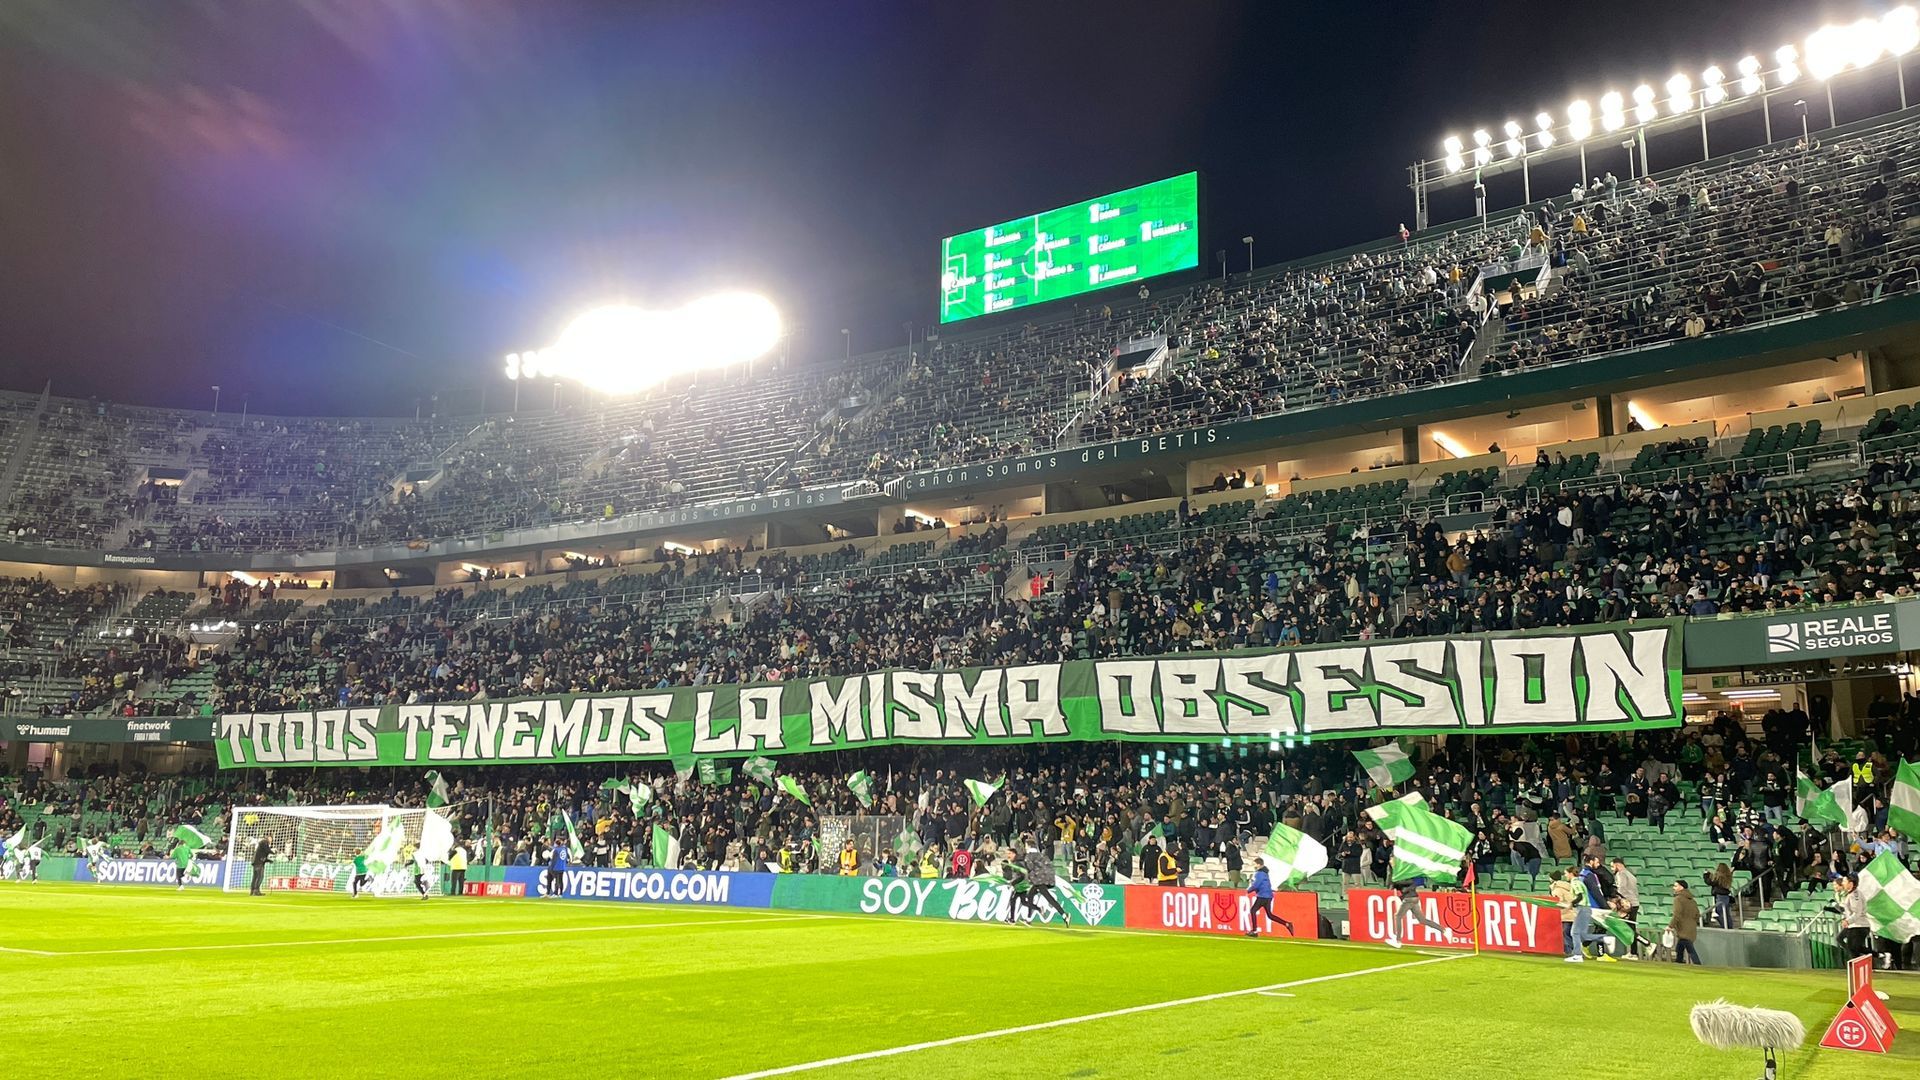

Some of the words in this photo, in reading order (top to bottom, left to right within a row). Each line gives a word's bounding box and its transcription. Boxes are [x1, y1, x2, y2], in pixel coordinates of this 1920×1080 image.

[713, 502, 757, 517] como
[772, 492, 825, 508] balas
[986, 457, 1057, 477] Somos
[1081, 445, 1117, 462] del
[1141, 429, 1230, 453] BETIS.
[104, 554, 155, 564] Manquepierda
[1803, 613, 1892, 637] REALE
[1805, 632, 1894, 650] SEGUROS
[221, 708, 381, 763] TODOS
[398, 693, 674, 760] TENEMOS
[691, 686, 785, 753] LA
[809, 662, 1070, 745] MISMA
[1094, 628, 1677, 734] OBSESION
[30, 725, 71, 736] hummel
[127, 721, 171, 731] finetwork
[98, 860, 219, 884] SOYBETICO.OM
[860, 878, 937, 916] SOY
[1162, 891, 1212, 929] COPA
[1239, 894, 1275, 933] RY
[1452, 936, 1476, 944] DEL
[1484, 899, 1538, 948] REY
